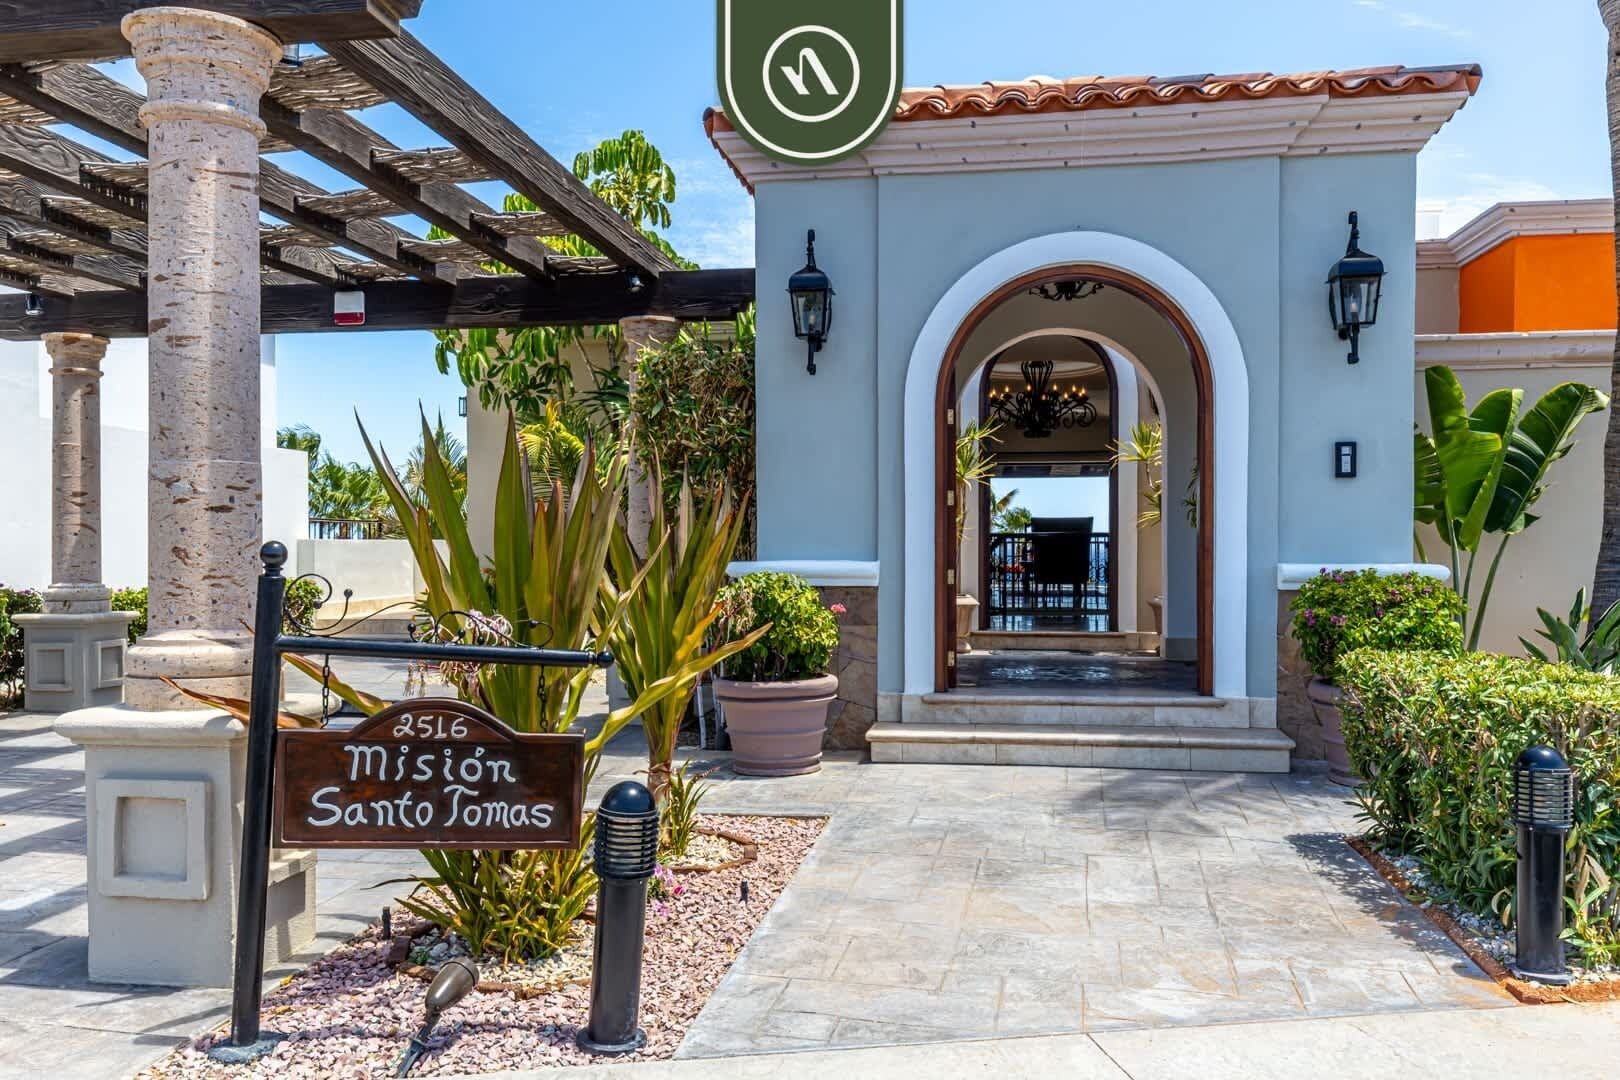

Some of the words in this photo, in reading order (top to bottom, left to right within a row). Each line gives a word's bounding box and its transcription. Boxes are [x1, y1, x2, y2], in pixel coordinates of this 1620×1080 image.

[392, 713, 469, 738] 2516
[344, 745, 517, 782] Misión
[307, 786, 433, 828] Santo
[443, 784, 555, 828] Tomas
